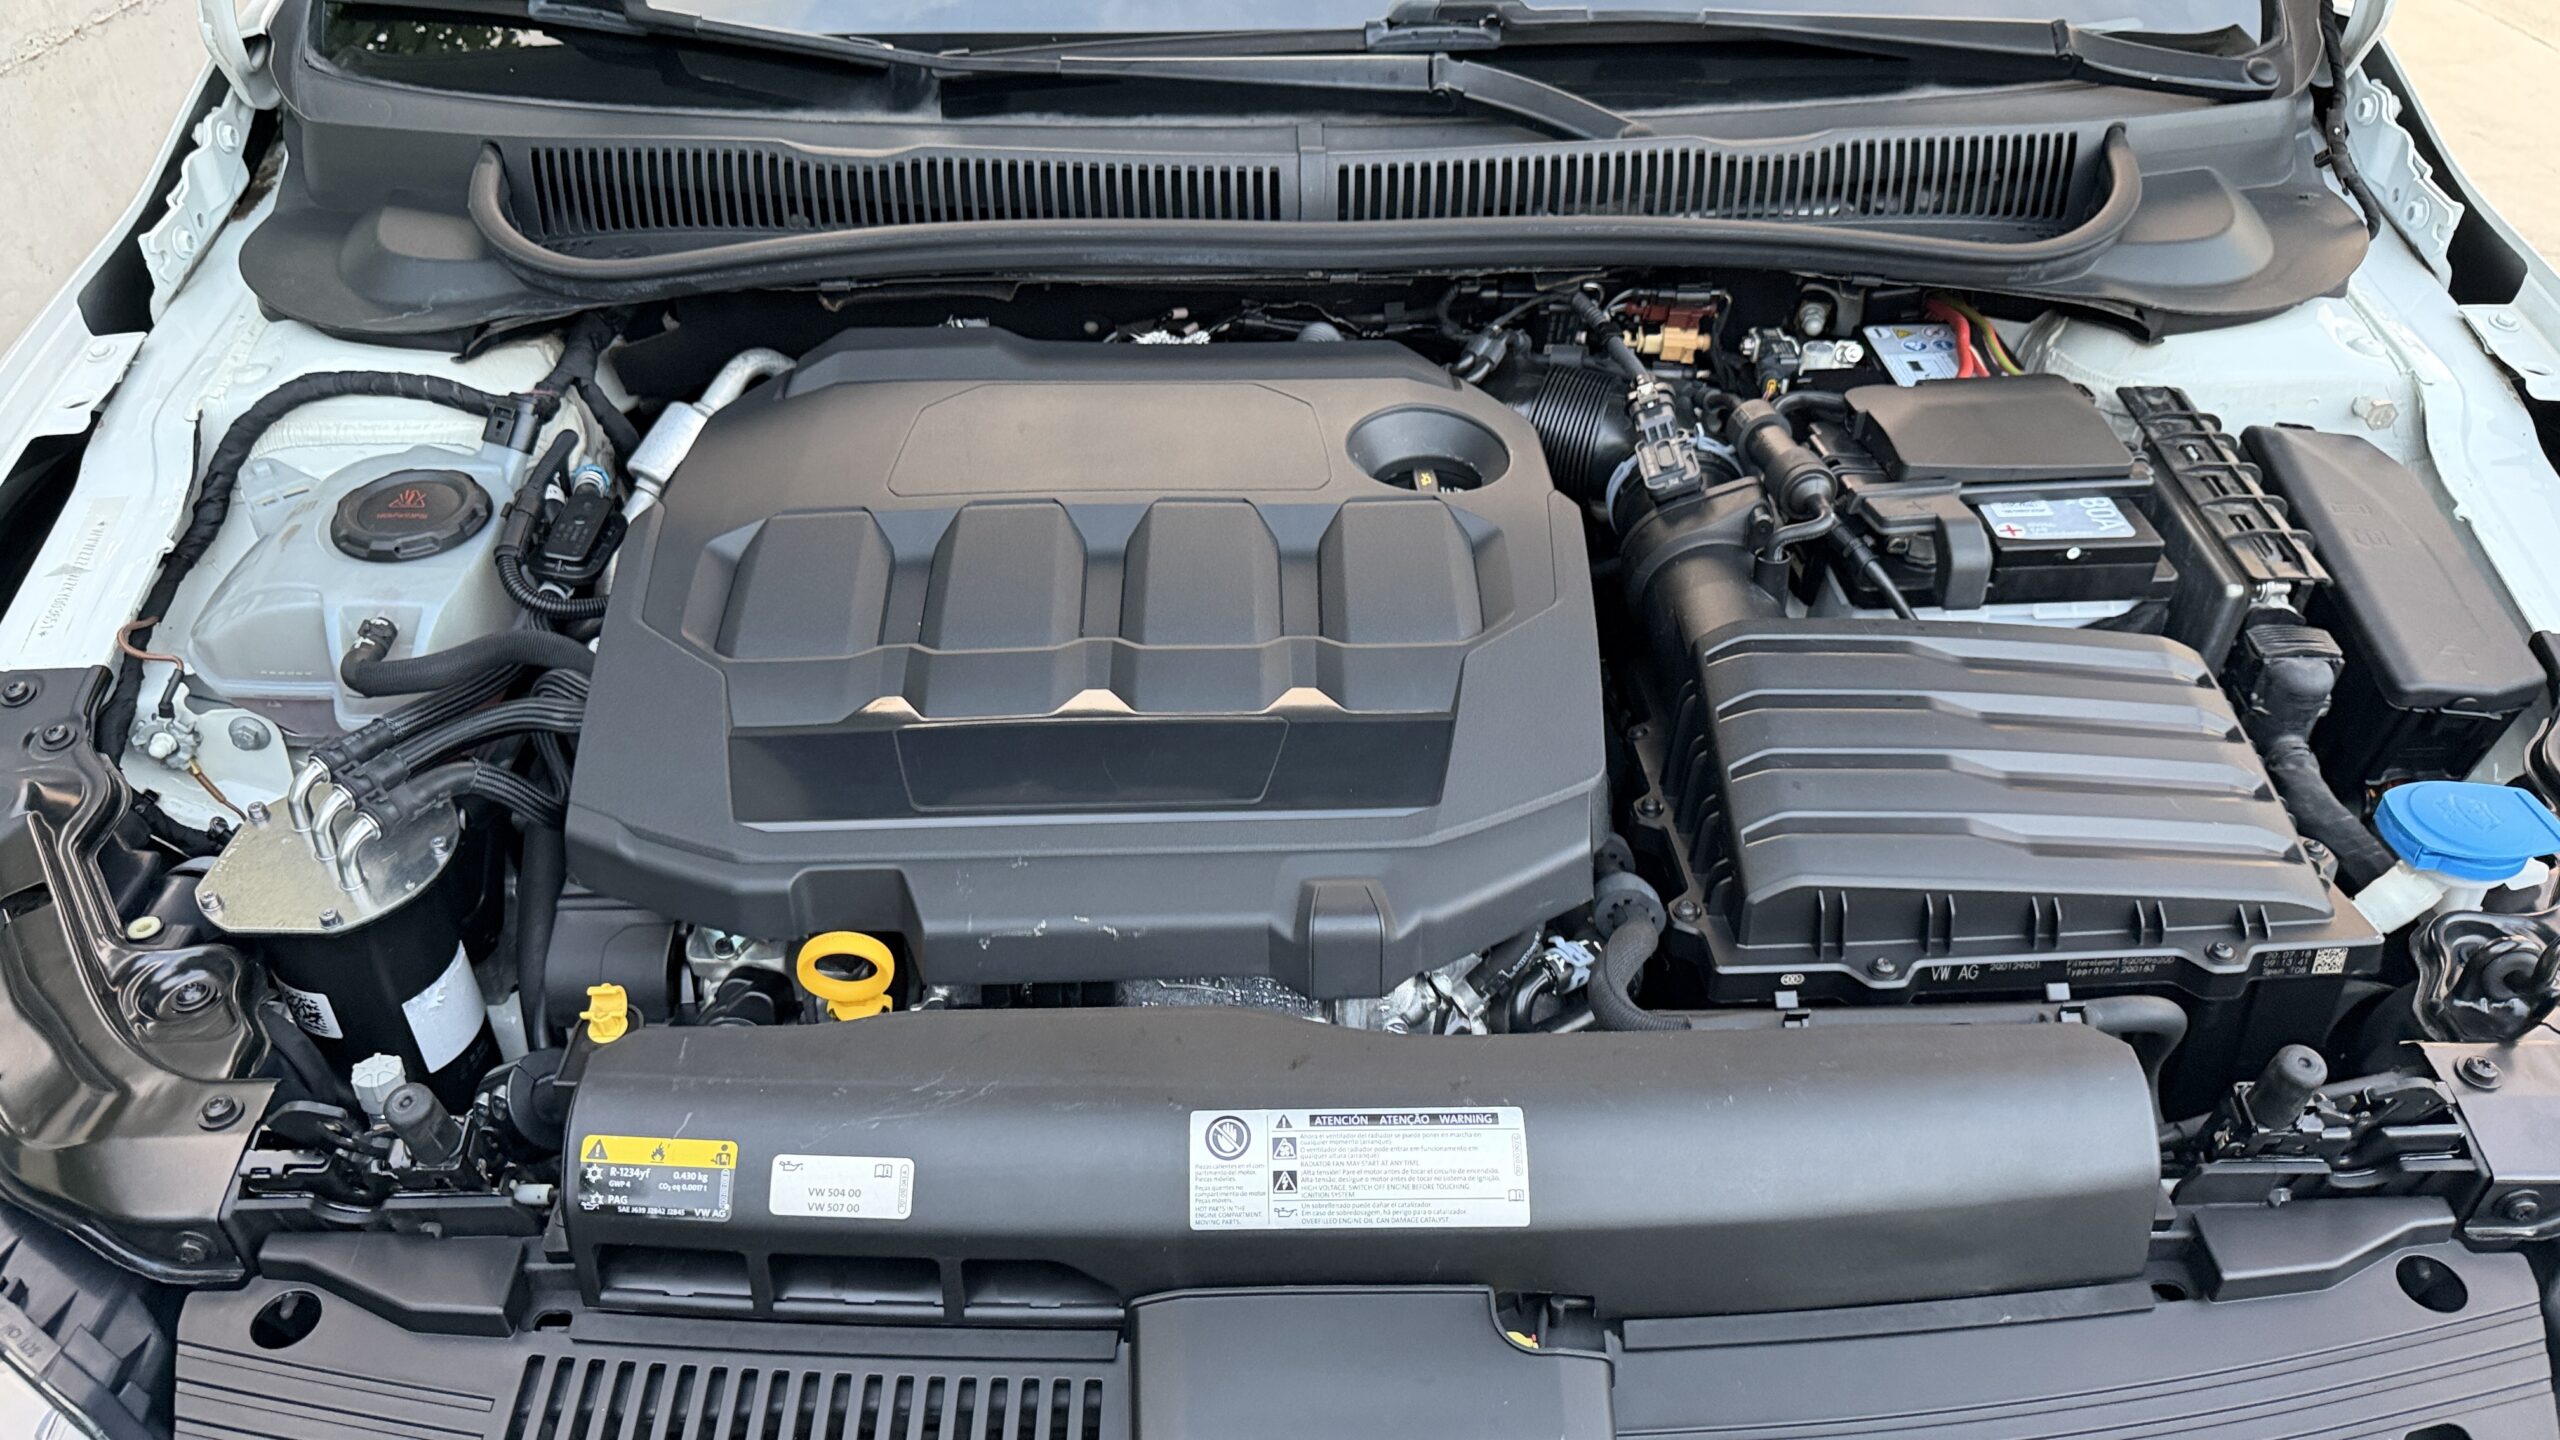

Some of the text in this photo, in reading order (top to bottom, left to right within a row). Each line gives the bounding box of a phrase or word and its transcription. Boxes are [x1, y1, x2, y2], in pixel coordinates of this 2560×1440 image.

[1931, 966, 1951, 981] VW
[1957, 965, 1979, 980] AG
[1314, 1113, 1493, 1127] ATENCIÓN ATENÇÃO WARNING
[610, 1167, 651, 1180] R-1234yf
[673, 1172, 708, 1182] 0.430 kg
[808, 1187, 862, 1198] VW 504 00
[608, 1195, 628, 1204] PAG
[808, 1202, 860, 1212] VW 507 00
[694, 1208, 726, 1218] VW AG
